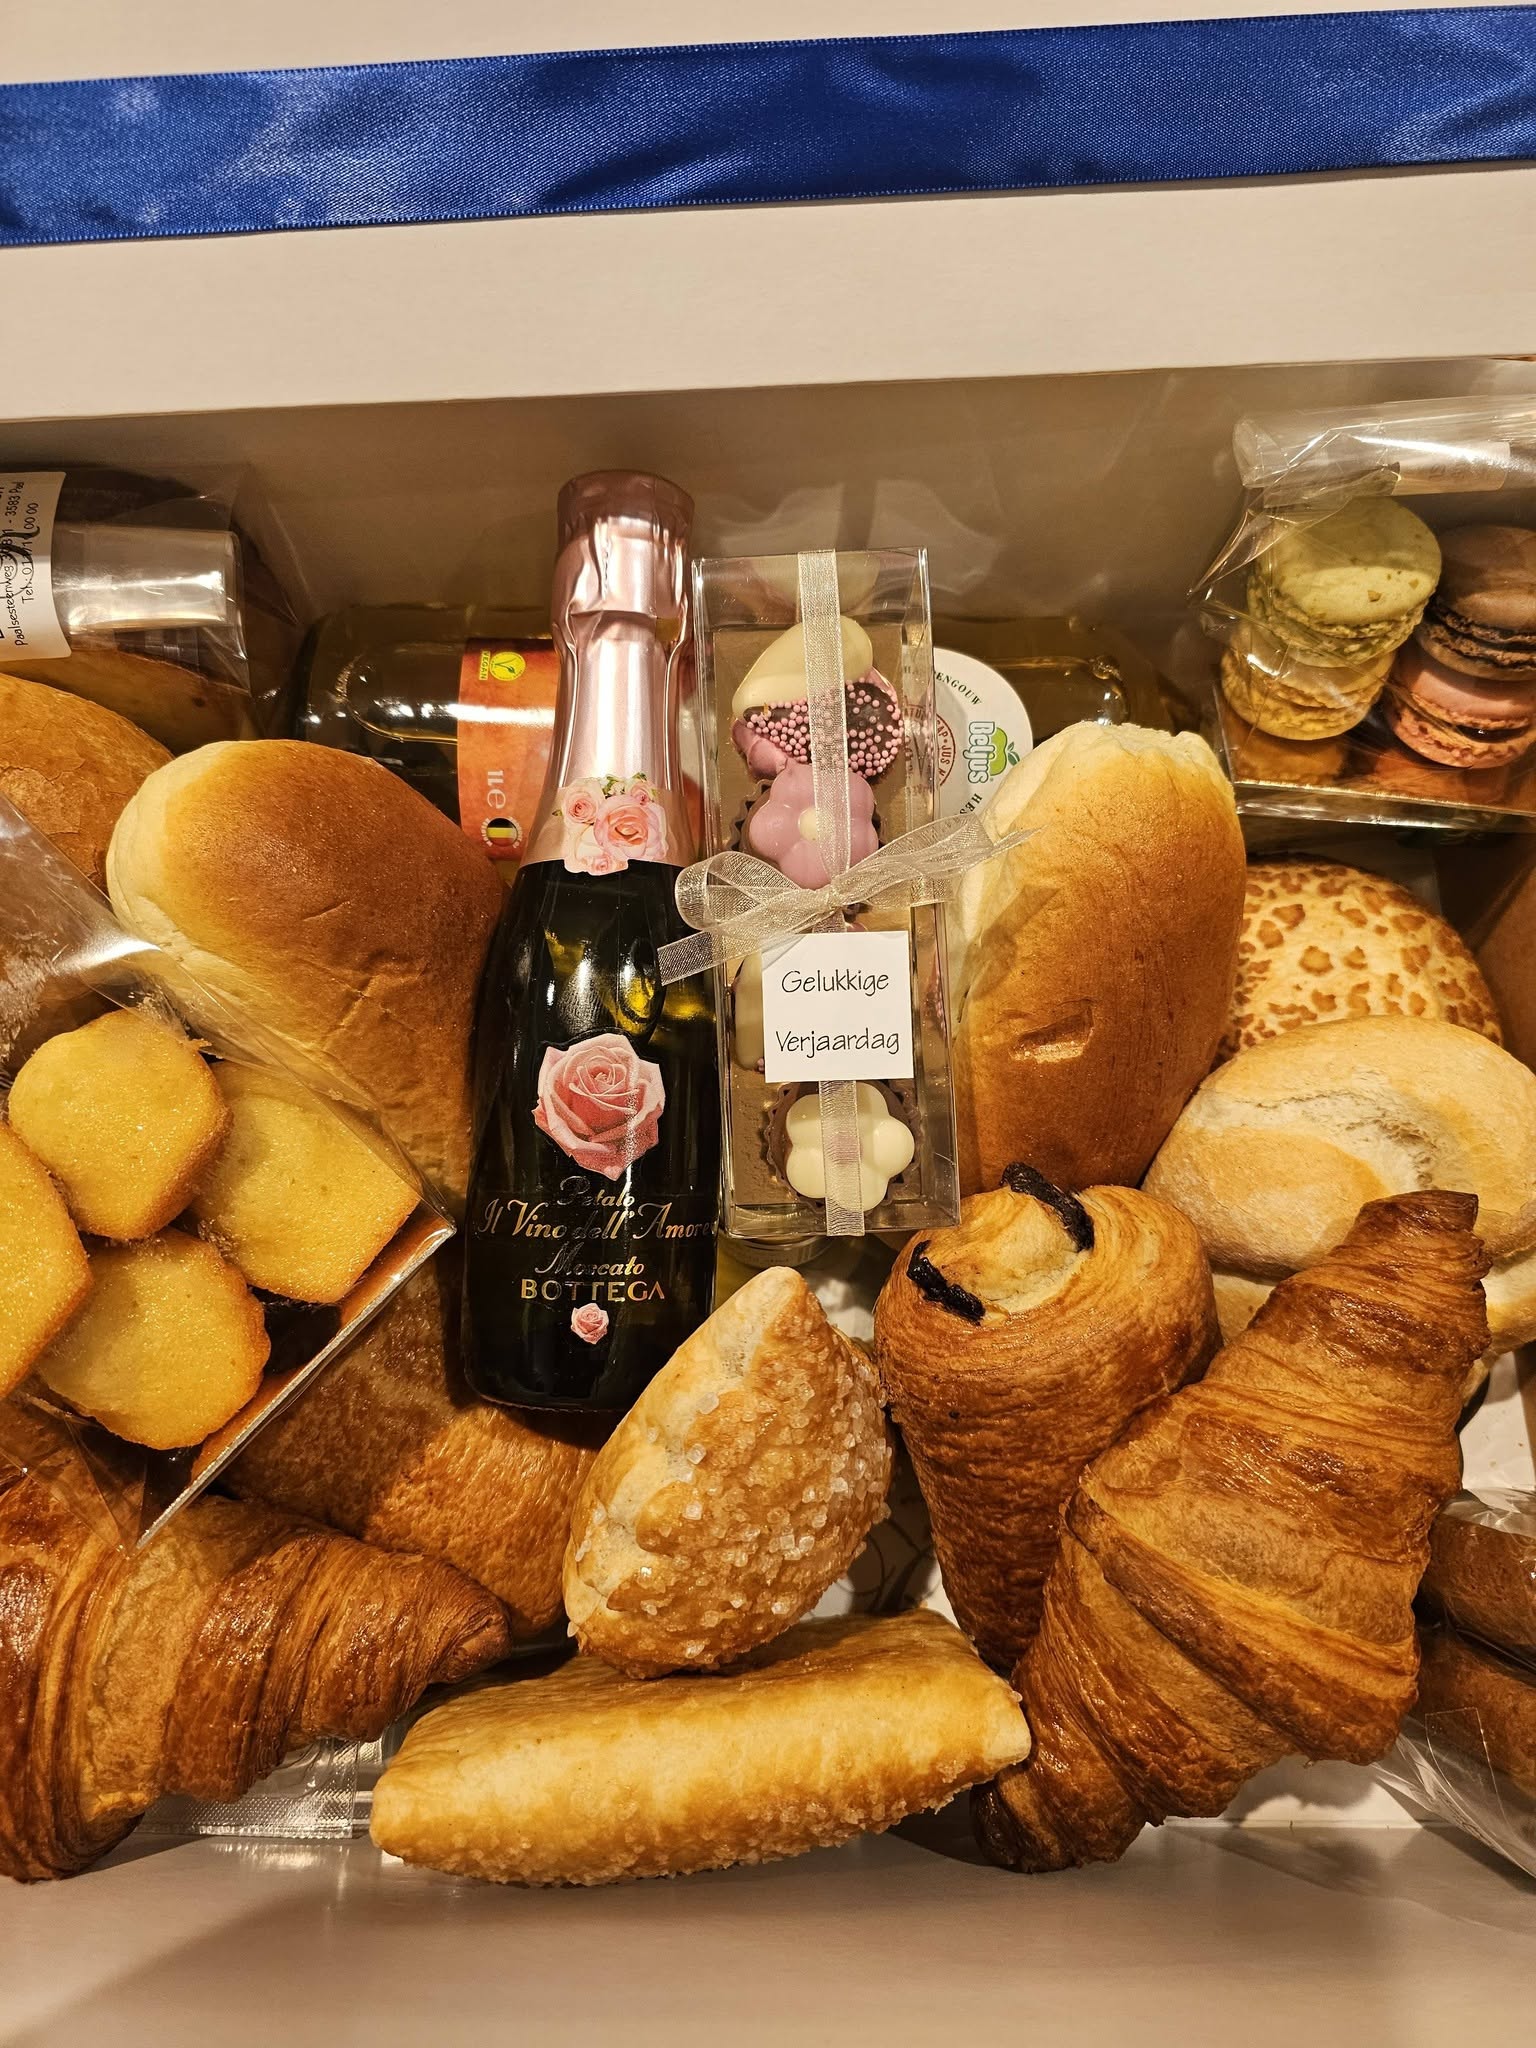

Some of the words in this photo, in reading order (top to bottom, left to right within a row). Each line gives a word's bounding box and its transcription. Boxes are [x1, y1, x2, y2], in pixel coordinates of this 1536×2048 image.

[5, 496, 21, 517] 3583
[480, 652, 489, 680] VEGAN
[940, 744, 952, 765] JUS
[963, 721, 996, 784] Beljus
[781, 968, 889, 997] Gelukkige
[775, 1027, 900, 1059] Verjaardag
[554, 1175, 636, 1207] Petalo
[477, 1198, 504, 1235] Il
[507, 1199, 568, 1240] Vino
[534, 1240, 646, 1277] Moscato
[520, 1278, 666, 1302] BOTTEGA
